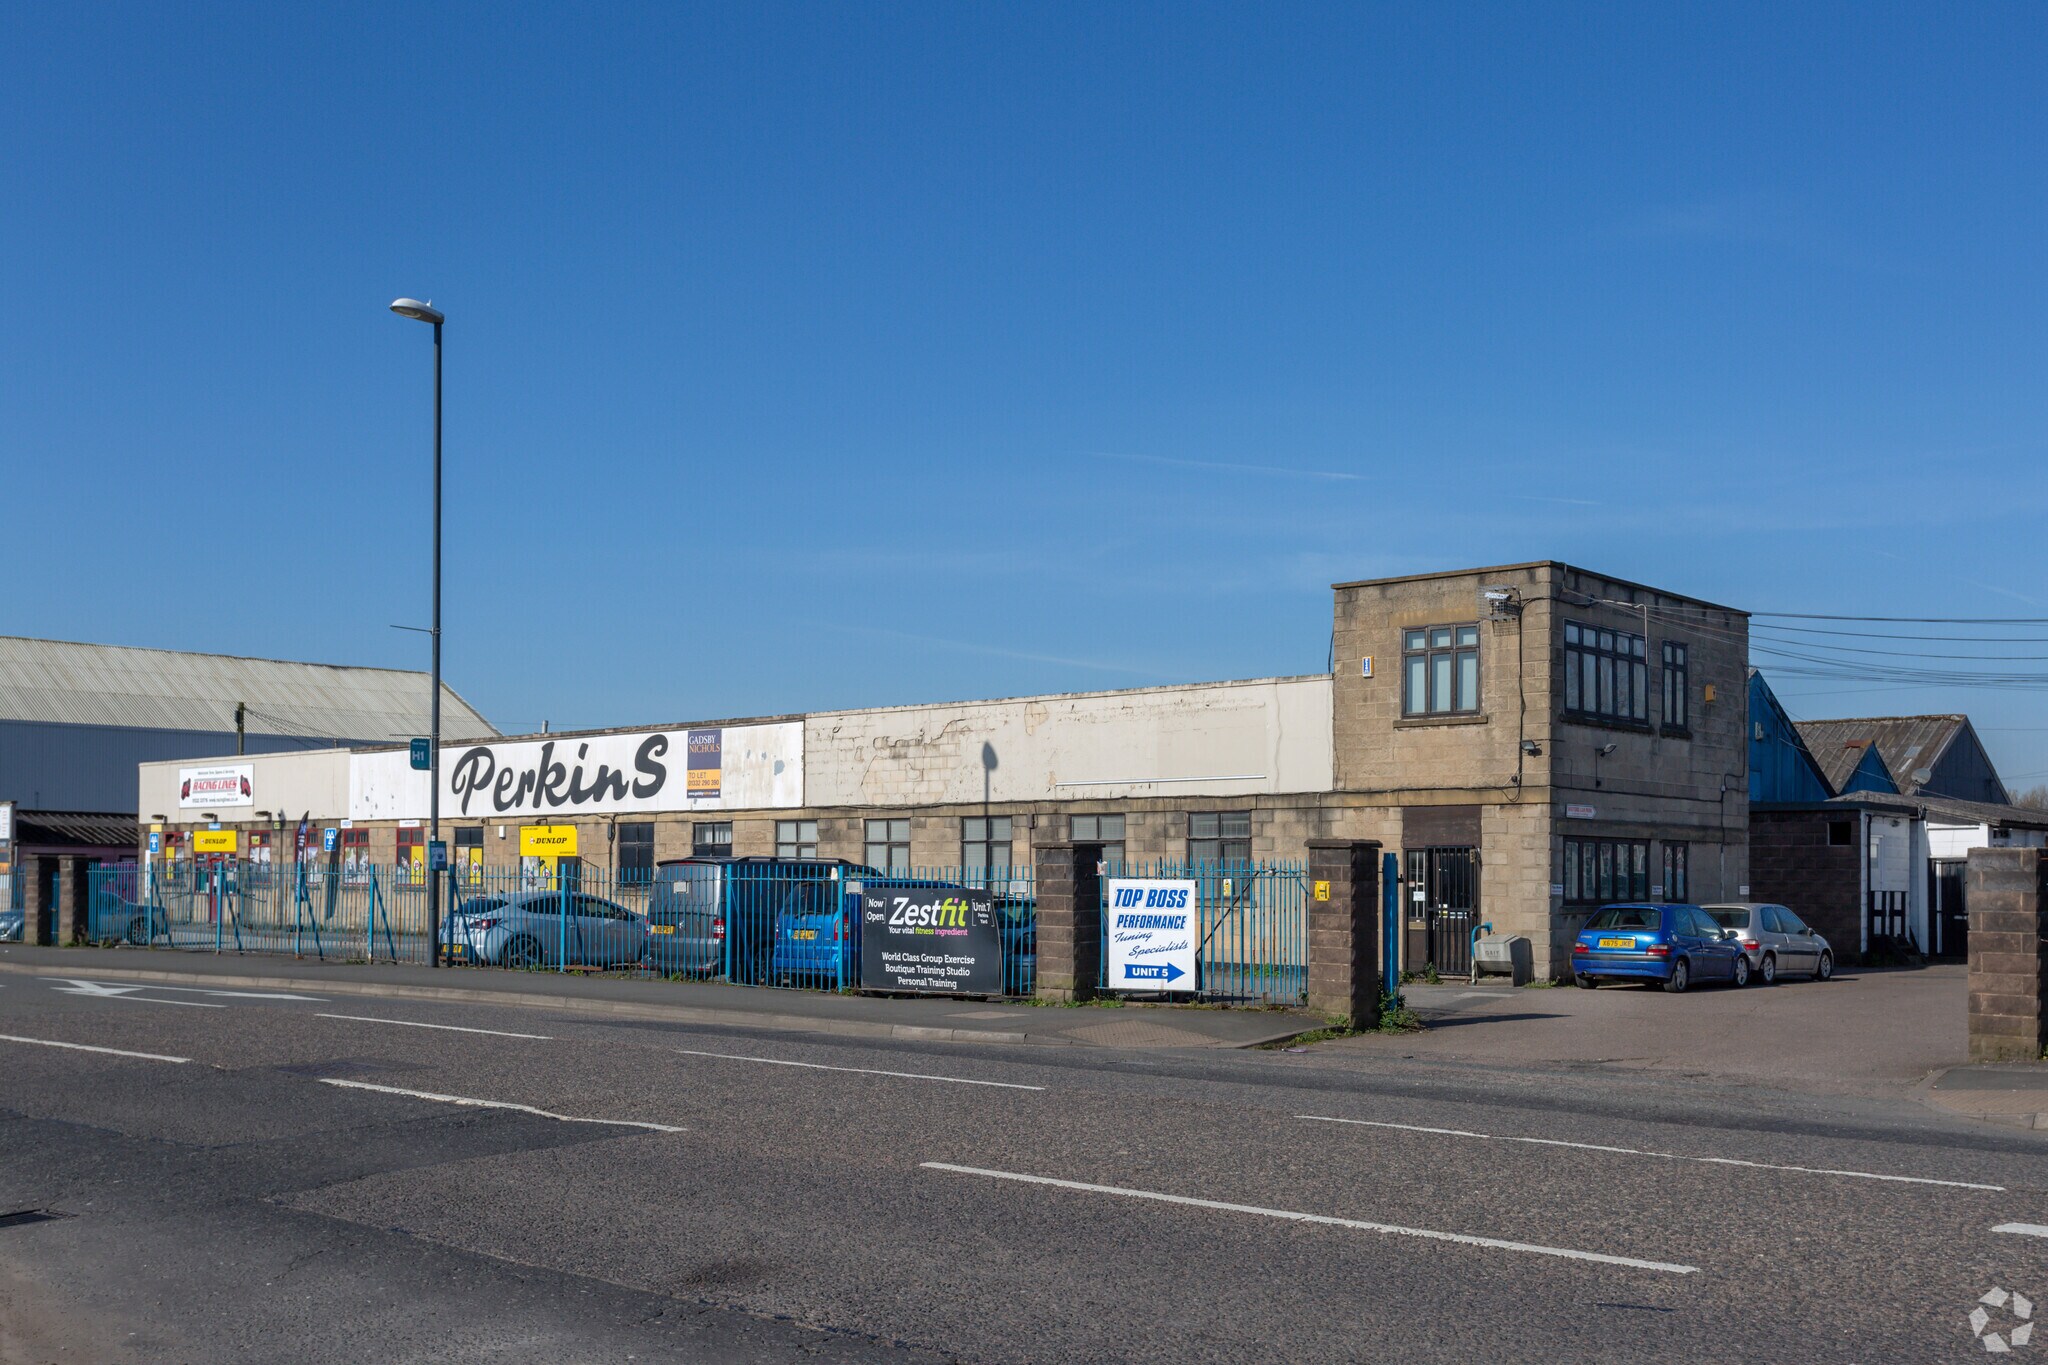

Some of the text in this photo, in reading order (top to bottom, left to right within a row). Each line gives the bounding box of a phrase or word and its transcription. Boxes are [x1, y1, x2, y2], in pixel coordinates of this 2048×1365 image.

[689, 735, 716, 745] GADSBY
[690, 743, 720, 753] NICHOLS
[412, 750, 424, 760] H1
[193, 779, 237, 790] RACING LINES
[868, 899, 884, 908] Now
[1115, 888, 1188, 908] TOP BOSS
[889, 897, 968, 926] Zestfit
[973, 902, 991, 912] Unit 7
[867, 911, 884, 922] Open
[1117, 914, 1186, 929] PERFORMANCE
[889, 926, 901, 934] Your
[915, 927, 934, 935] fitness
[935, 928, 968, 937] ingredient
[1115, 931, 1153, 942] Tuning
[1129, 940, 1188, 959] Specialists
[882, 951, 975, 965] World Class Group Exercise
[885, 964, 971, 977] Boutique Training Studio
[1132, 967, 1169, 977] UNIT 5
[898, 976, 957, 989] Personal Training
